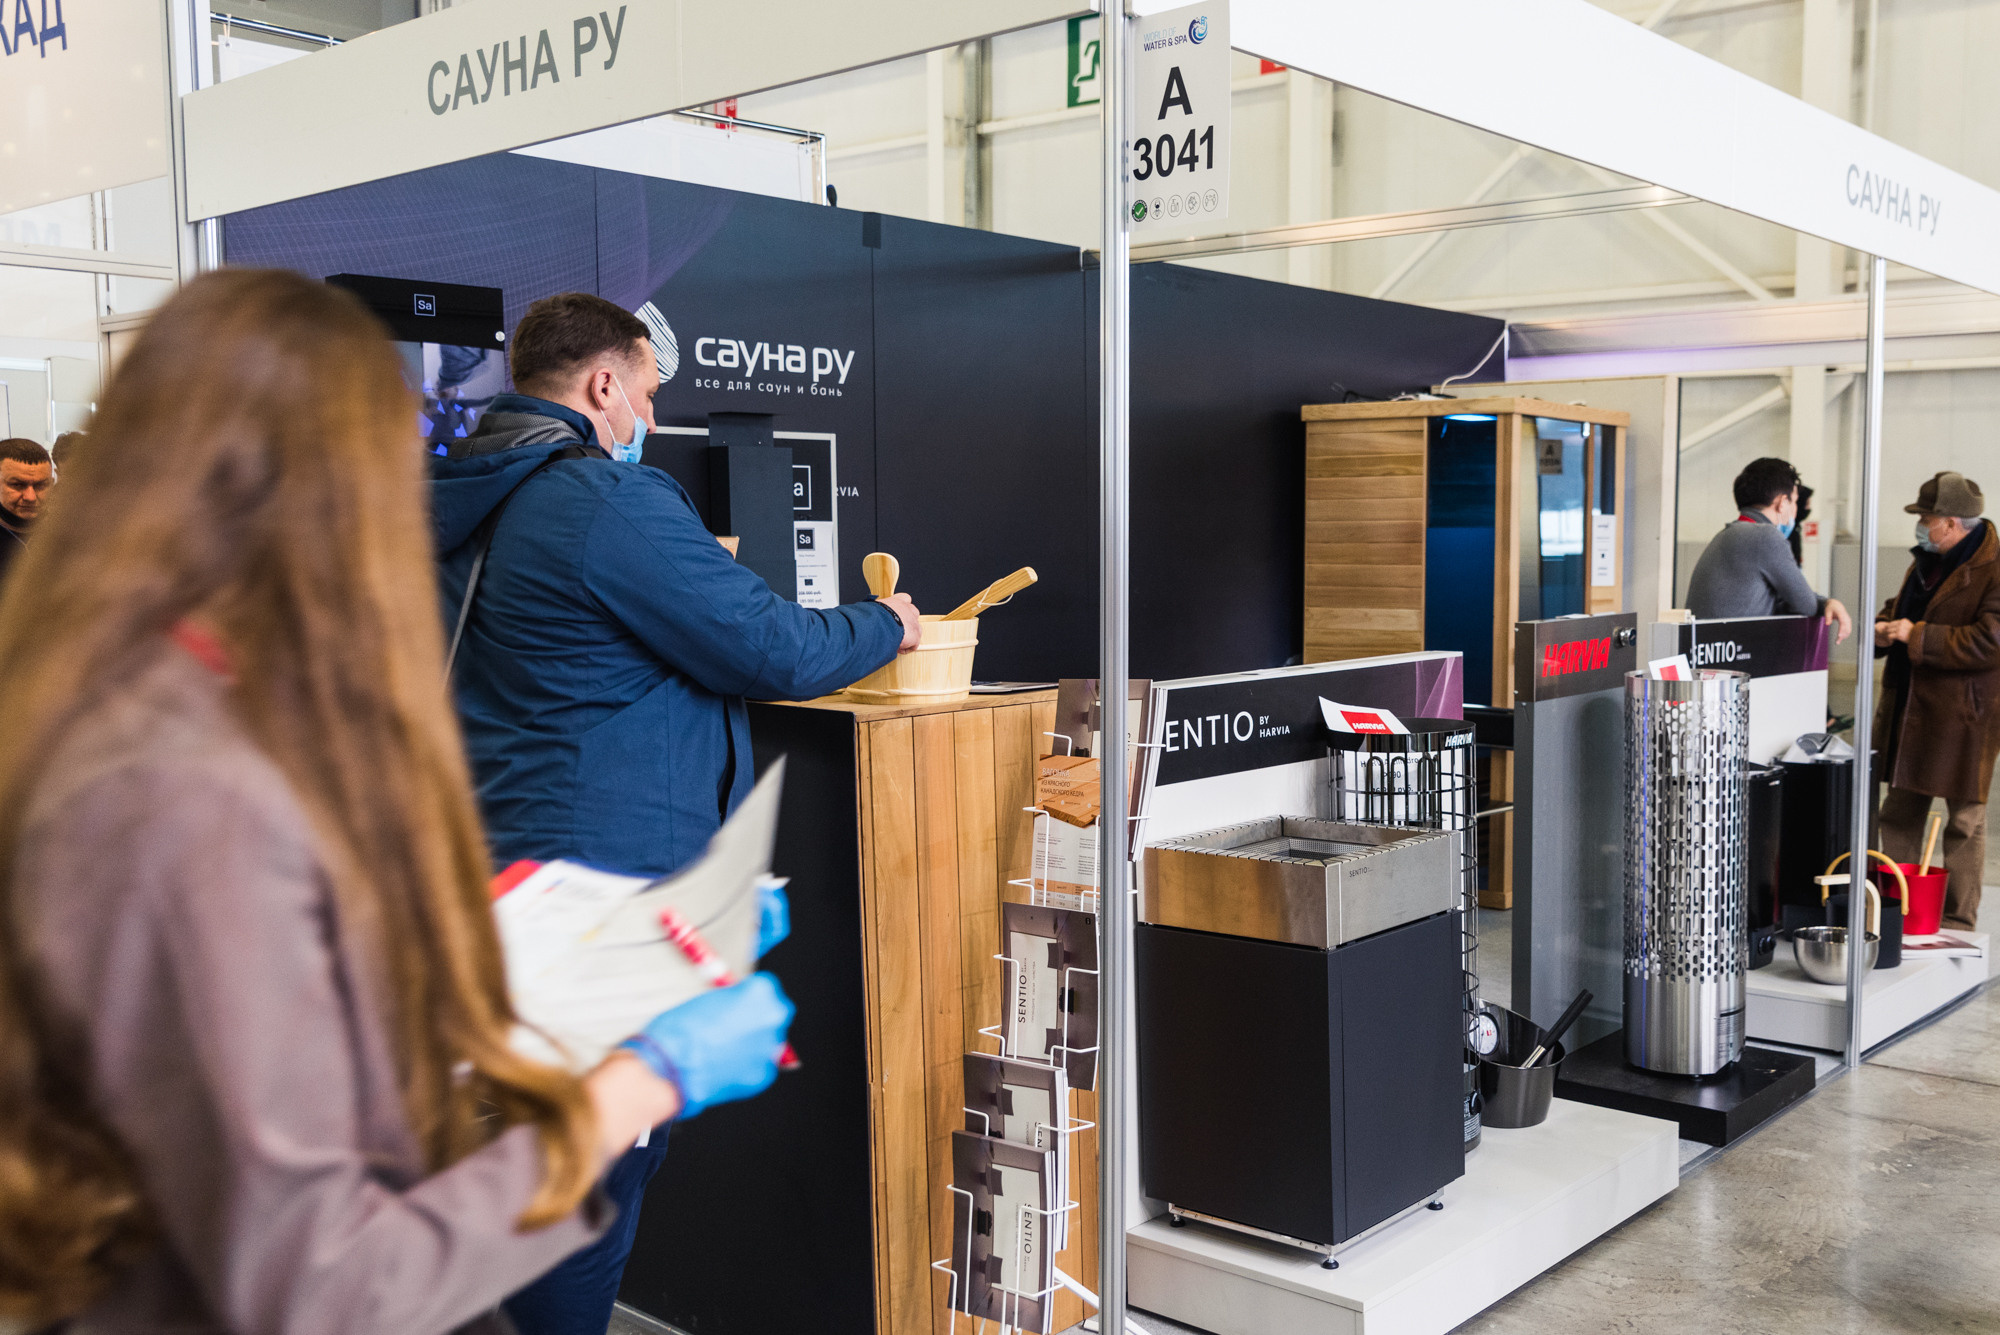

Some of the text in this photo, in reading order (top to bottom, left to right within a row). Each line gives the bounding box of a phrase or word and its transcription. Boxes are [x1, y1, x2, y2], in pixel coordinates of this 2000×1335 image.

[1143, 28, 1167, 42] WORLD
[1143, 34, 1188, 52] WATER & SPA
[427, 5, 627, 116] САУНА РУ
[1157, 66, 1193, 121] A
[1132, 125, 1214, 181] 3041
[1846, 163, 1941, 237] САУНА РУ
[418, 299, 432, 311] Sa
[695, 337, 855, 385] сауна ру
[695, 378, 843, 397] все для саун и бань
[793, 482, 804, 497] a
[799, 533, 812, 545] Sa
[1541, 636, 1612, 678] HARVIA
[1689, 640, 1736, 666] SENTIO
[1165, 710, 1270, 753] ENTIO BY
[1259, 725, 1291, 738] HARVIA
[1351, 722, 1387, 731] HARVIA
[1444, 732, 1473, 748] HARVIA
[1349, 866, 1368, 878] SENTIO
[1018, 975, 1027, 1023] SENTIO
